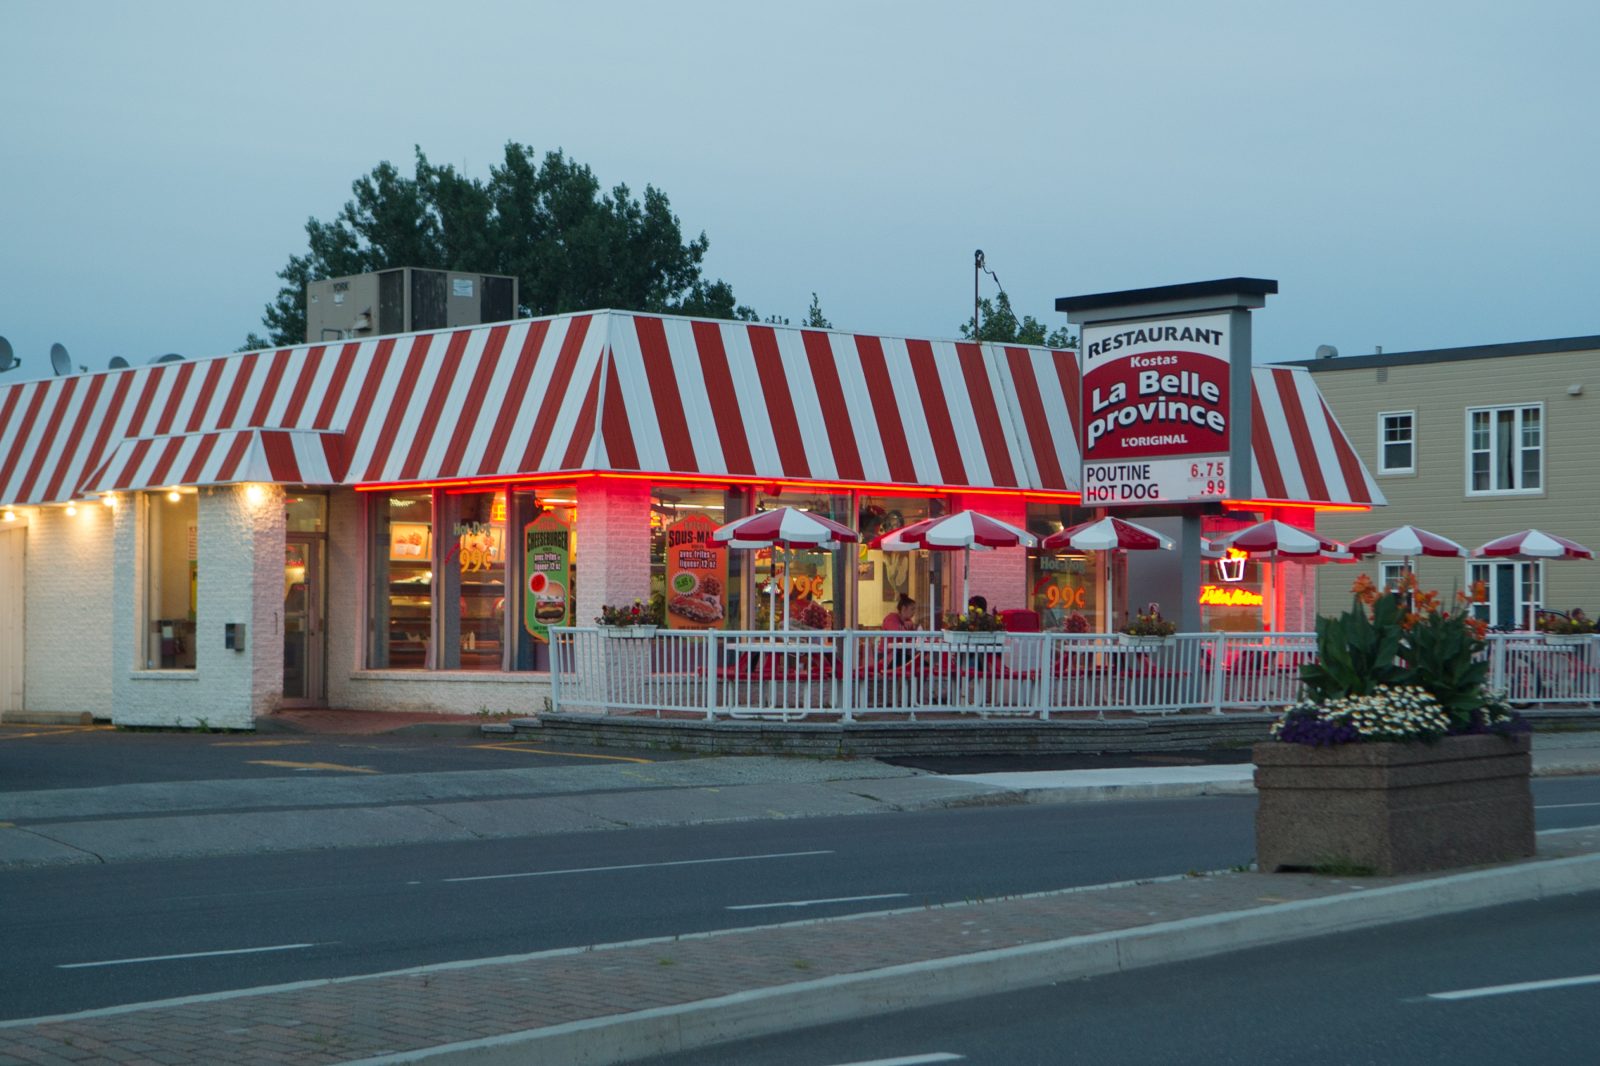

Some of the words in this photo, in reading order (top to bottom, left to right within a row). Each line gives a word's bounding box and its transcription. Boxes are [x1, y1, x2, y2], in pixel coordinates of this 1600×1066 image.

[1088, 326, 1224, 359] RESTAURANT
[1130, 355, 1178, 368] Kostas
[1092, 382, 1127, 413] La
[1139, 370, 1221, 404] Belle
[1087, 396, 1226, 450] province
[1121, 434, 1189, 448] L'ORIGINAL
[1086, 464, 1151, 483] POUTINE
[1190, 462, 1225, 478] 6.75
[1086, 485, 1118, 502] HOT
[1121, 483, 1160, 500] DOG
[1200, 480, 1226, 495] .99
[527, 530, 568, 553] CHEESEBURGER
[459, 549, 492, 573] 99¢
[778, 574, 825, 600] 99¢
[1046, 585, 1087, 609] 99¢
